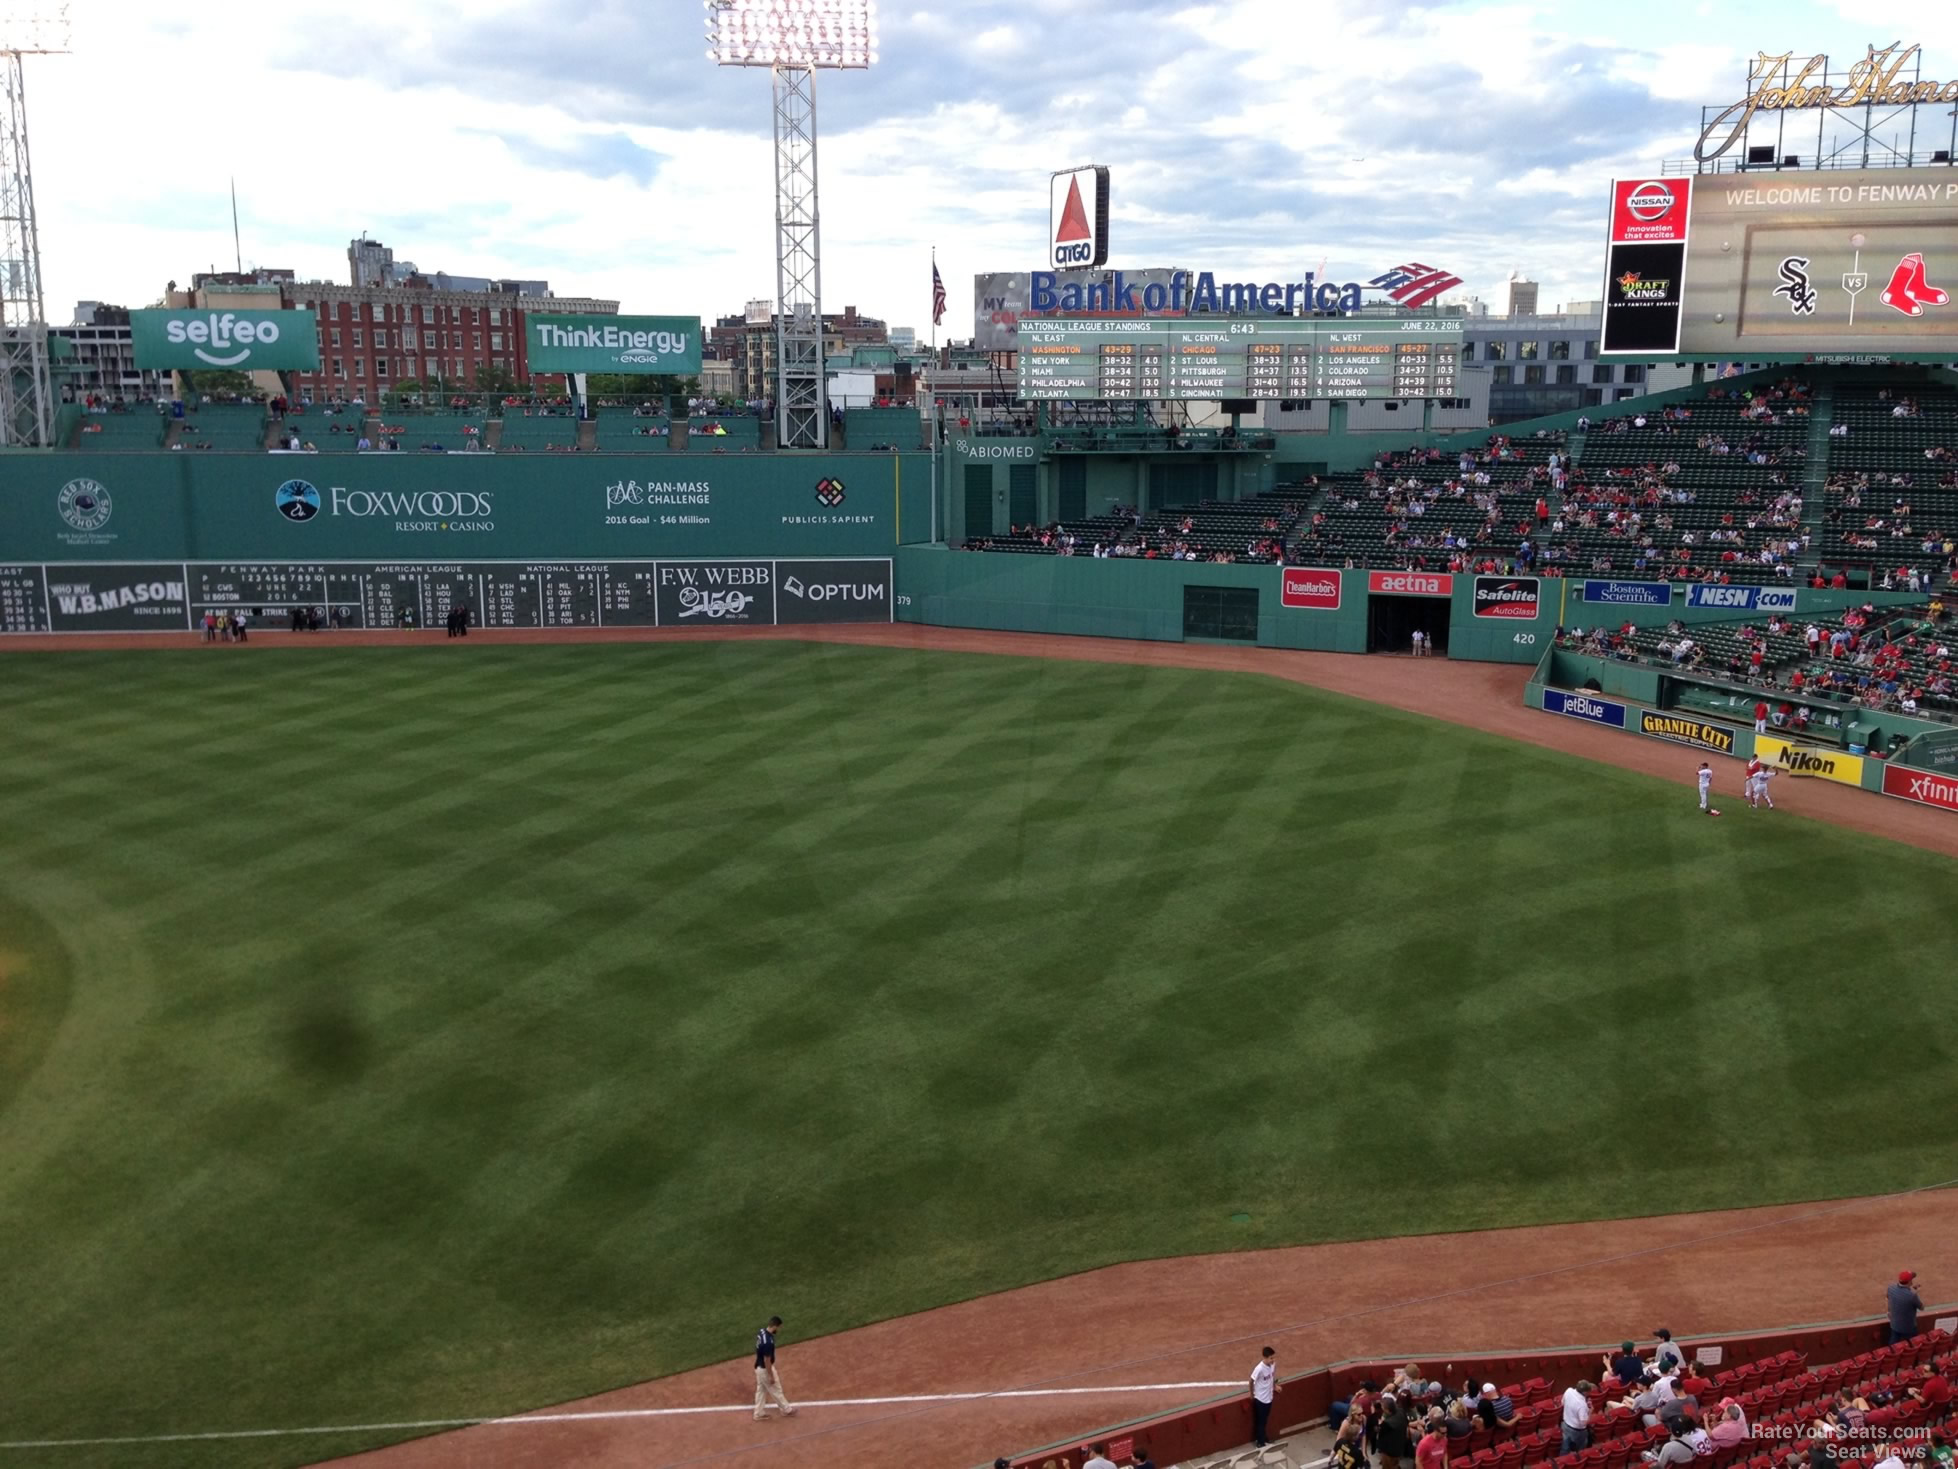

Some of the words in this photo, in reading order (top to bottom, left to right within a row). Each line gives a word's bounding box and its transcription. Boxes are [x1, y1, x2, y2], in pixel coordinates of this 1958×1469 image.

[1694, 50, 1833, 162] John
[1630, 196, 1670, 206] NISSAN
[1726, 187, 1821, 206] WELCOME
[1828, 186, 1852, 203] TO
[1858, 184, 1941, 202] FENWAY
[1622, 281, 1668, 292] DRAFT
[1848, 278, 1862, 288] VS
[1030, 271, 1138, 312] Bank
[1142, 271, 1188, 312] of
[1189, 272, 1362, 313] America
[1627, 289, 1666, 298] KINGS
[984, 298, 1005, 311] MY
[1021, 322, 1066, 331] NATIONAL
[1068, 322, 1102, 331] LEAGUE
[1104, 322, 1151, 331] STANDINGS
[1231, 324, 1255, 334] 6:43
[1401, 322, 1422, 330] JUNE
[1424, 322, 1438, 331] 22,
[1441, 322, 1460, 330] 2016
[536, 324, 686, 354] ThinkEnergy
[1032, 345, 1081, 354] WASHINGTON
[968, 446, 1034, 457] ABIOMED
[61, 484, 77, 504] RED
[80, 480, 101, 495] SOX
[648, 482, 710, 493] PAN-MASS
[329, 487, 492, 517] FOXWOODS
[648, 494, 710, 504] CHALLENGE
[64, 499, 109, 528] SCHOLARS
[605, 515, 627, 524] 2016
[628, 515, 650, 524] Goal
[660, 515, 676, 525] $46
[678, 515, 710, 524] Million
[395, 522, 438, 531] RESORT
[450, 521, 494, 531] CASINO
[661, 568, 699, 585] F.W.
[704, 568, 769, 585] WEBB
[73, 584, 90, 594] BUT
[1381, 576, 1439, 592] aetna
[1610, 583, 1645, 594] Boston
[58, 582, 184, 614] W.B.MASON
[808, 584, 884, 601] OPTUM
[1476, 588, 1536, 602] Safelite
[1601, 588, 1658, 603] Scientific
[897, 595, 911, 605] 379
[1492, 606, 1536, 617] AutoGlass
[1513, 634, 1535, 644] 420
[1562, 694, 1604, 717] jetBlue
[1644, 716, 1700, 738] GRANITE
[1701, 725, 1732, 749] CITY
[1659, 731, 1689, 742] ELECTRIC
[1690, 738, 1714, 748] SUPPLY
[1779, 746, 1835, 774] Nikon
